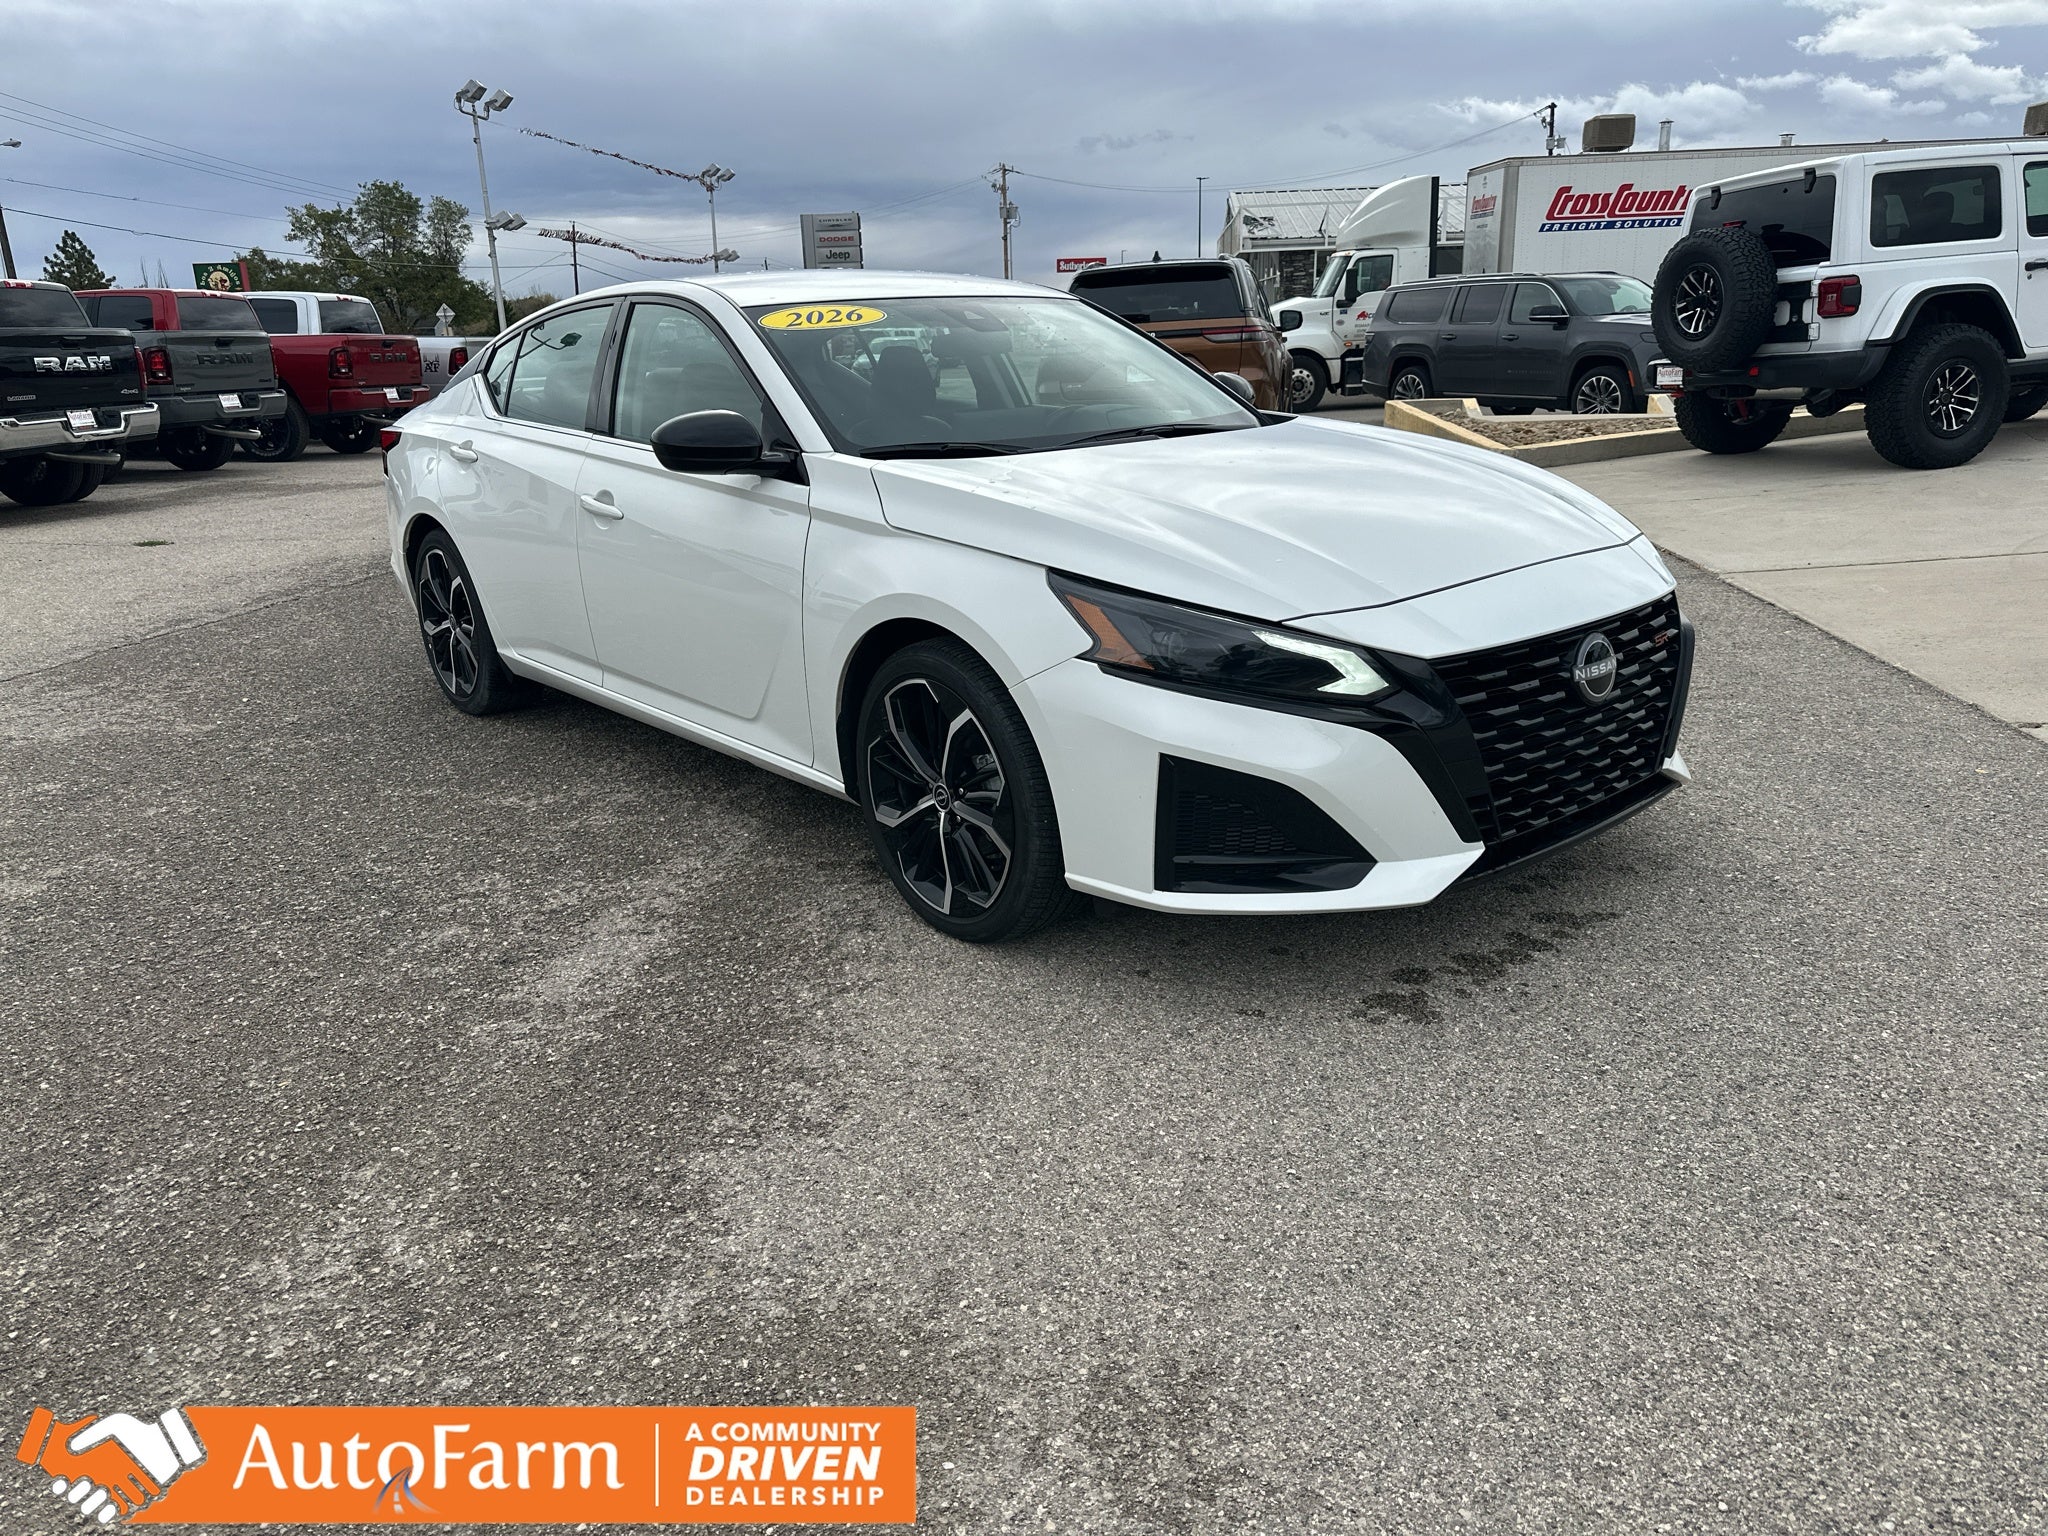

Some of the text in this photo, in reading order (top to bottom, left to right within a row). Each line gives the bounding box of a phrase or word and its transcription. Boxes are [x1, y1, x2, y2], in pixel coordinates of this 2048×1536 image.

[1545, 183, 1693, 221] CrossCountr
[1542, 221, 1607, 232] FREIGHT
[825, 249, 851, 261] Jeep
[1059, 260, 1088, 271] Sutherl
[786, 308, 863, 328] 2026
[33, 355, 113, 372] RAM
[196, 352, 254, 365] RAM
[369, 352, 407, 362] RAM
[1655, 631, 1669, 647] SR
[1575, 658, 1616, 680] NISSAN
